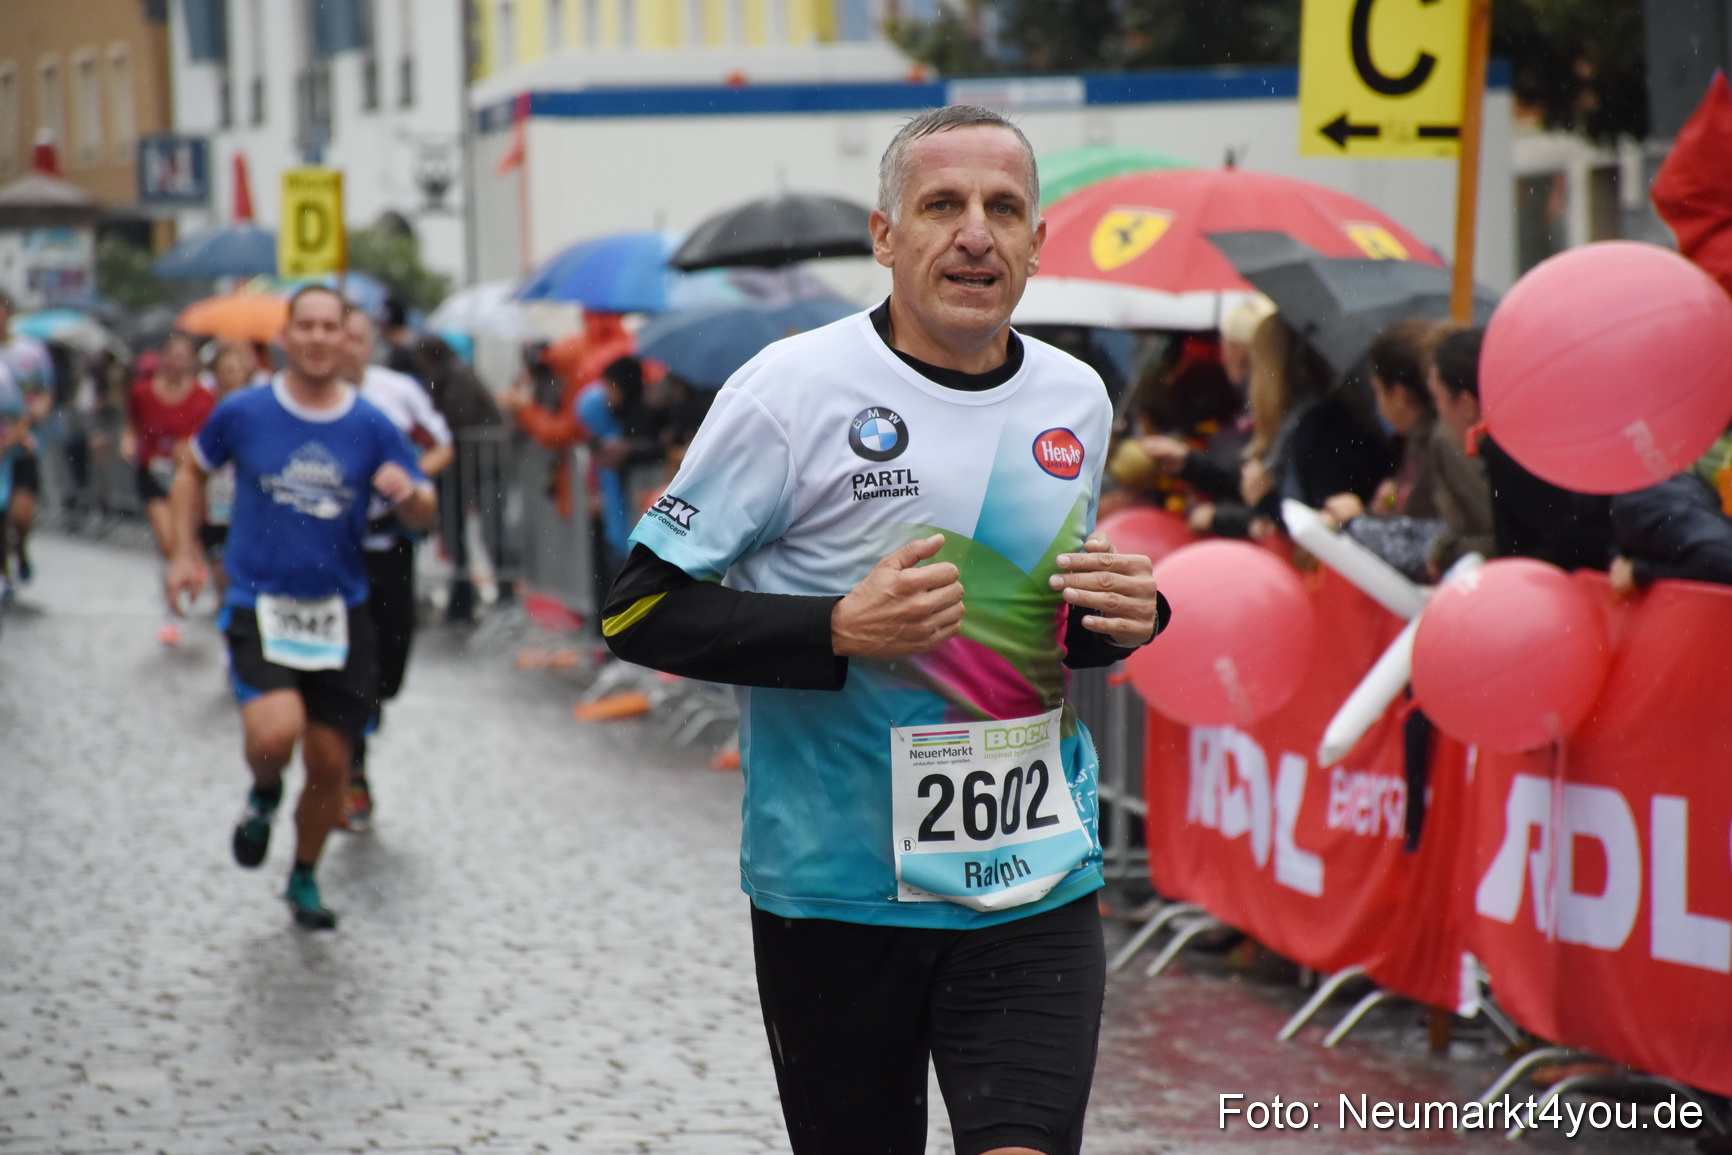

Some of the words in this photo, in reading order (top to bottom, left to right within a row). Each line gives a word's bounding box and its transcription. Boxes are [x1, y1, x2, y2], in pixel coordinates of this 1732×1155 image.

[1350, 0, 1439, 97] C
[296, 202, 329, 253] D
[853, 408, 902, 430] BMW
[1041, 440, 1081, 467] Hervis
[852, 468, 919, 489] PARTL
[853, 485, 920, 501] Neumarkt
[657, 515, 687, 537] concepts
[984, 721, 1050, 751] BOCK
[909, 746, 973, 760] NeuerMarkt
[984, 751, 1012, 760] inspired
[917, 759, 1060, 842] 2602
[1187, 725, 1325, 898] RDL
[903, 840, 912, 851] B
[964, 854, 1032, 889] Ralph
[1475, 773, 1732, 974] RDL
